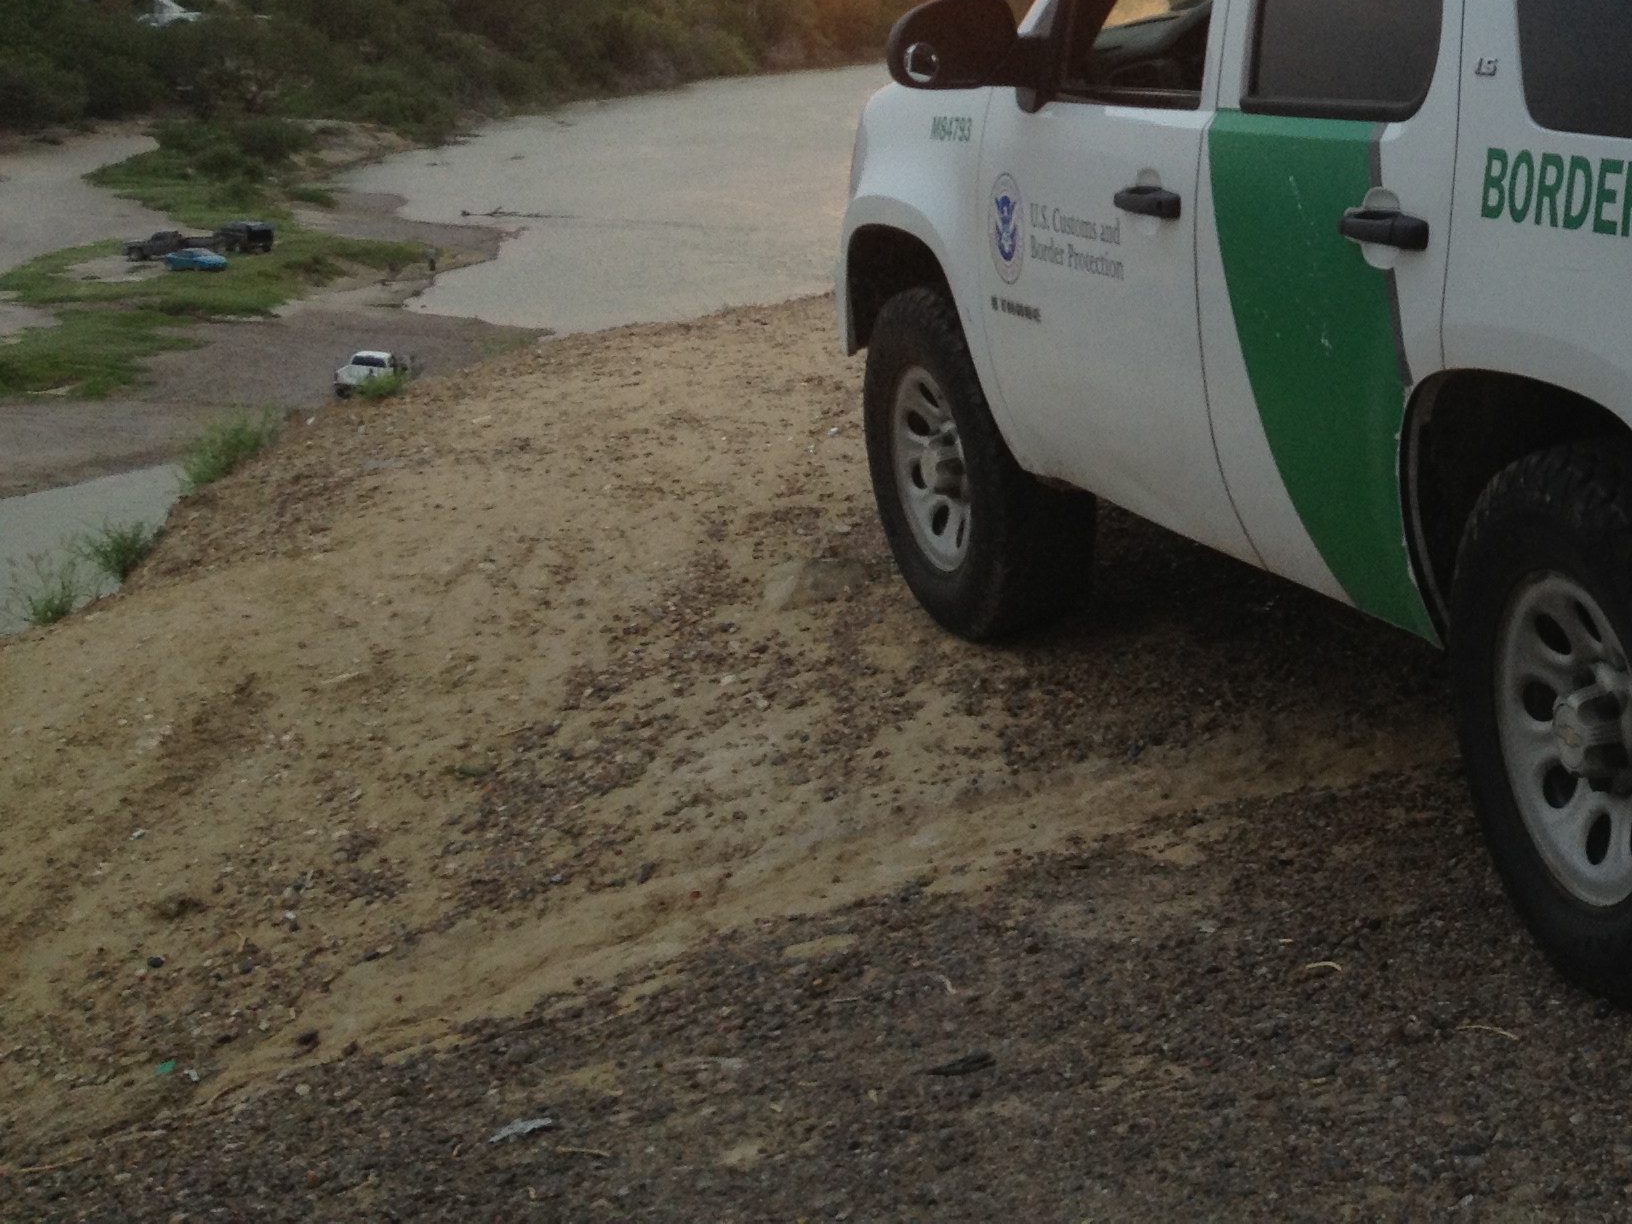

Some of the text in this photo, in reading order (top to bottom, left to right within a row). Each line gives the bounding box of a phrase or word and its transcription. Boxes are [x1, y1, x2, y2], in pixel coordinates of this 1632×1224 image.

[930, 116, 972, 142] M84793
[1030, 203, 1121, 245] U.S. Customs and
[1031, 235, 1125, 280] Border Protection
